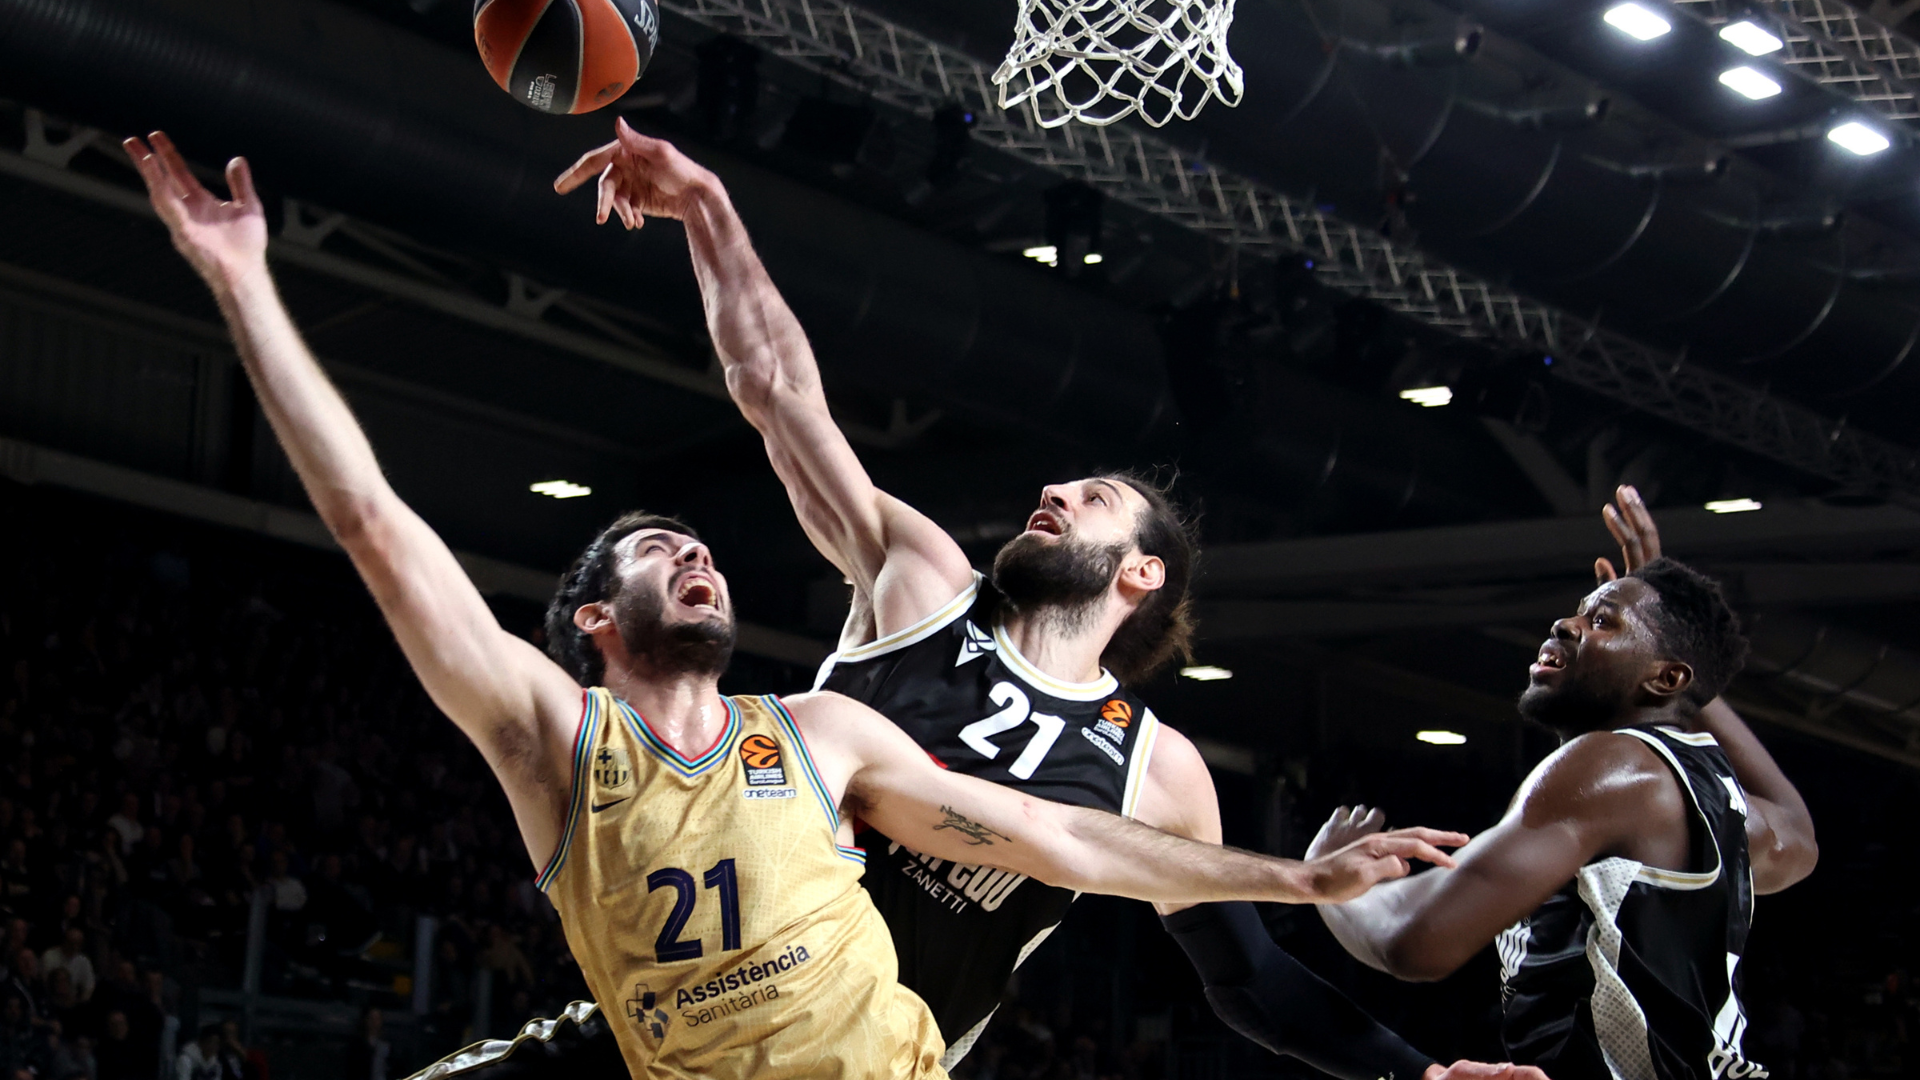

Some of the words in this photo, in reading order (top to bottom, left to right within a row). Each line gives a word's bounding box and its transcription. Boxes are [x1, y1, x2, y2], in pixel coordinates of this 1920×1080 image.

[958, 681, 1067, 780] 21
[744, 788, 797, 798] oneteam
[647, 858, 742, 963] 21
[901, 860, 968, 914] ZANETTI
[675, 944, 811, 1009] Assistència
[682, 981, 779, 1028] Sanitària
